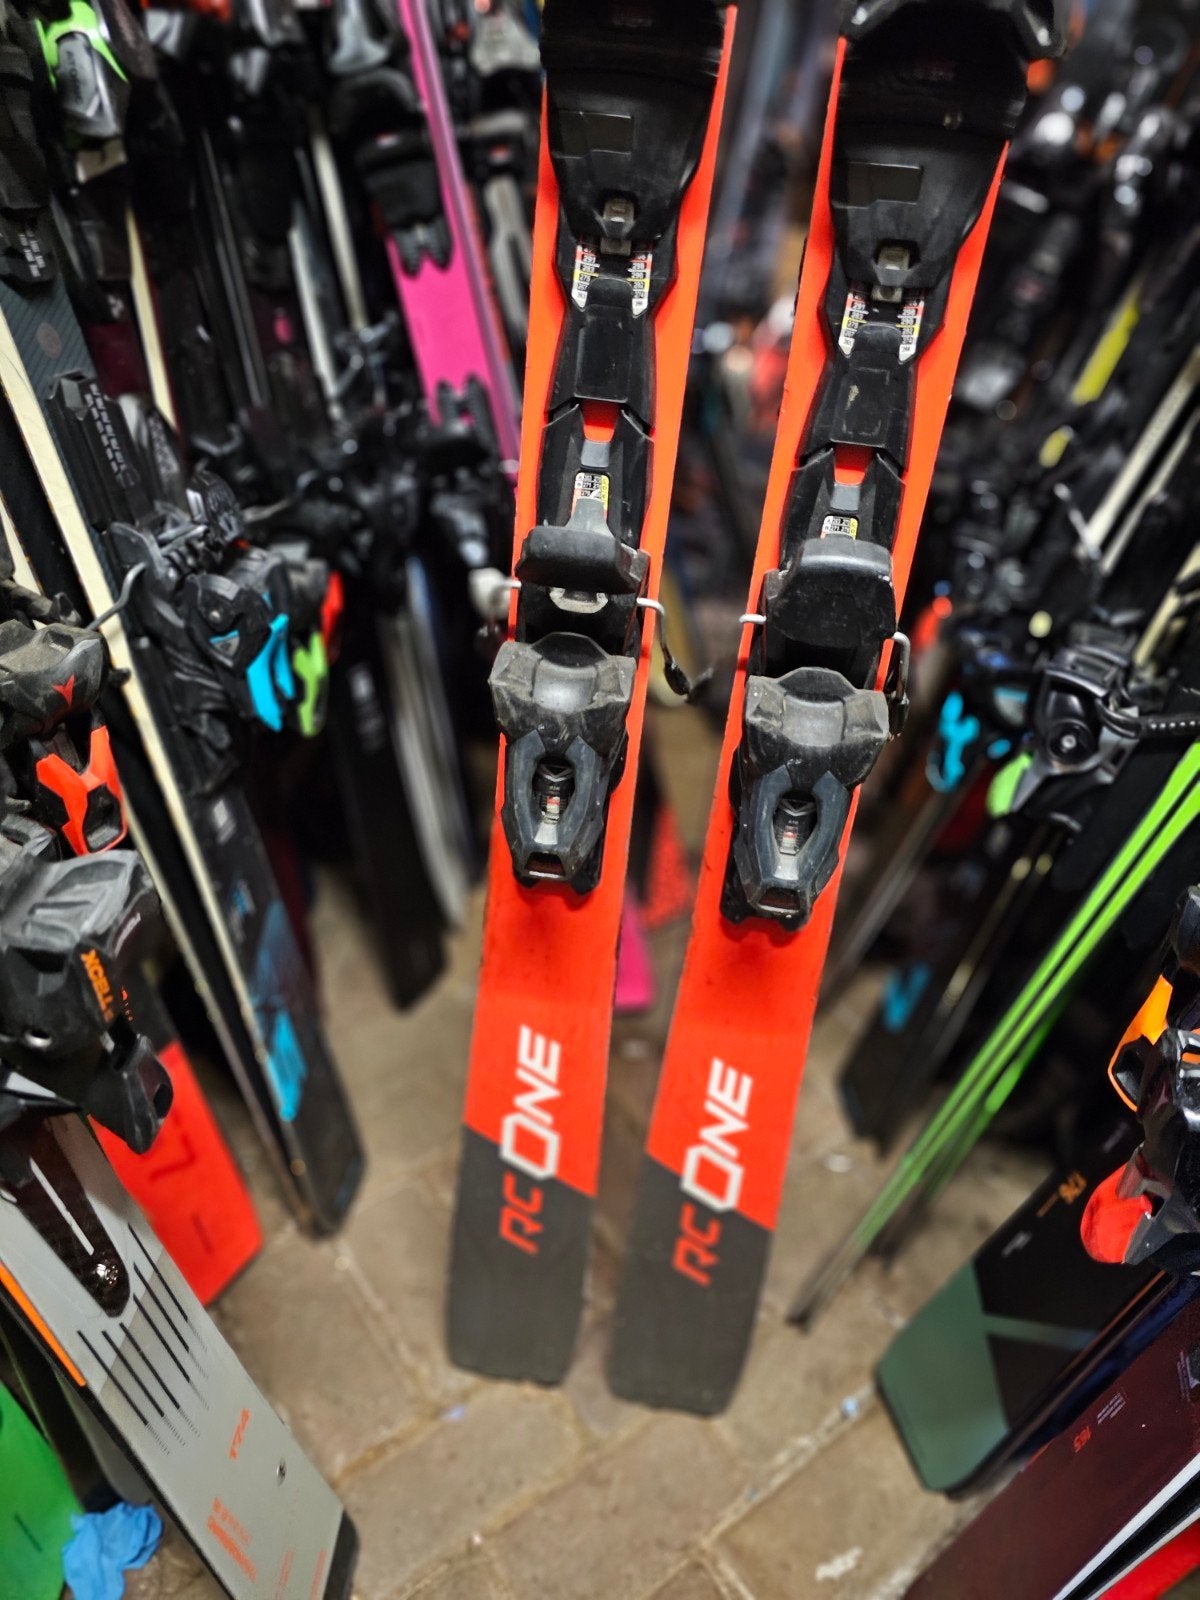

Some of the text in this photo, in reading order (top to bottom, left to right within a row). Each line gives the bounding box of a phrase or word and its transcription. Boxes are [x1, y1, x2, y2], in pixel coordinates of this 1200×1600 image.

[80, 949, 114, 1011] XCELL
[499, 1024, 561, 1255] RC ONE
[673, 1056, 752, 1287] RC ONE
